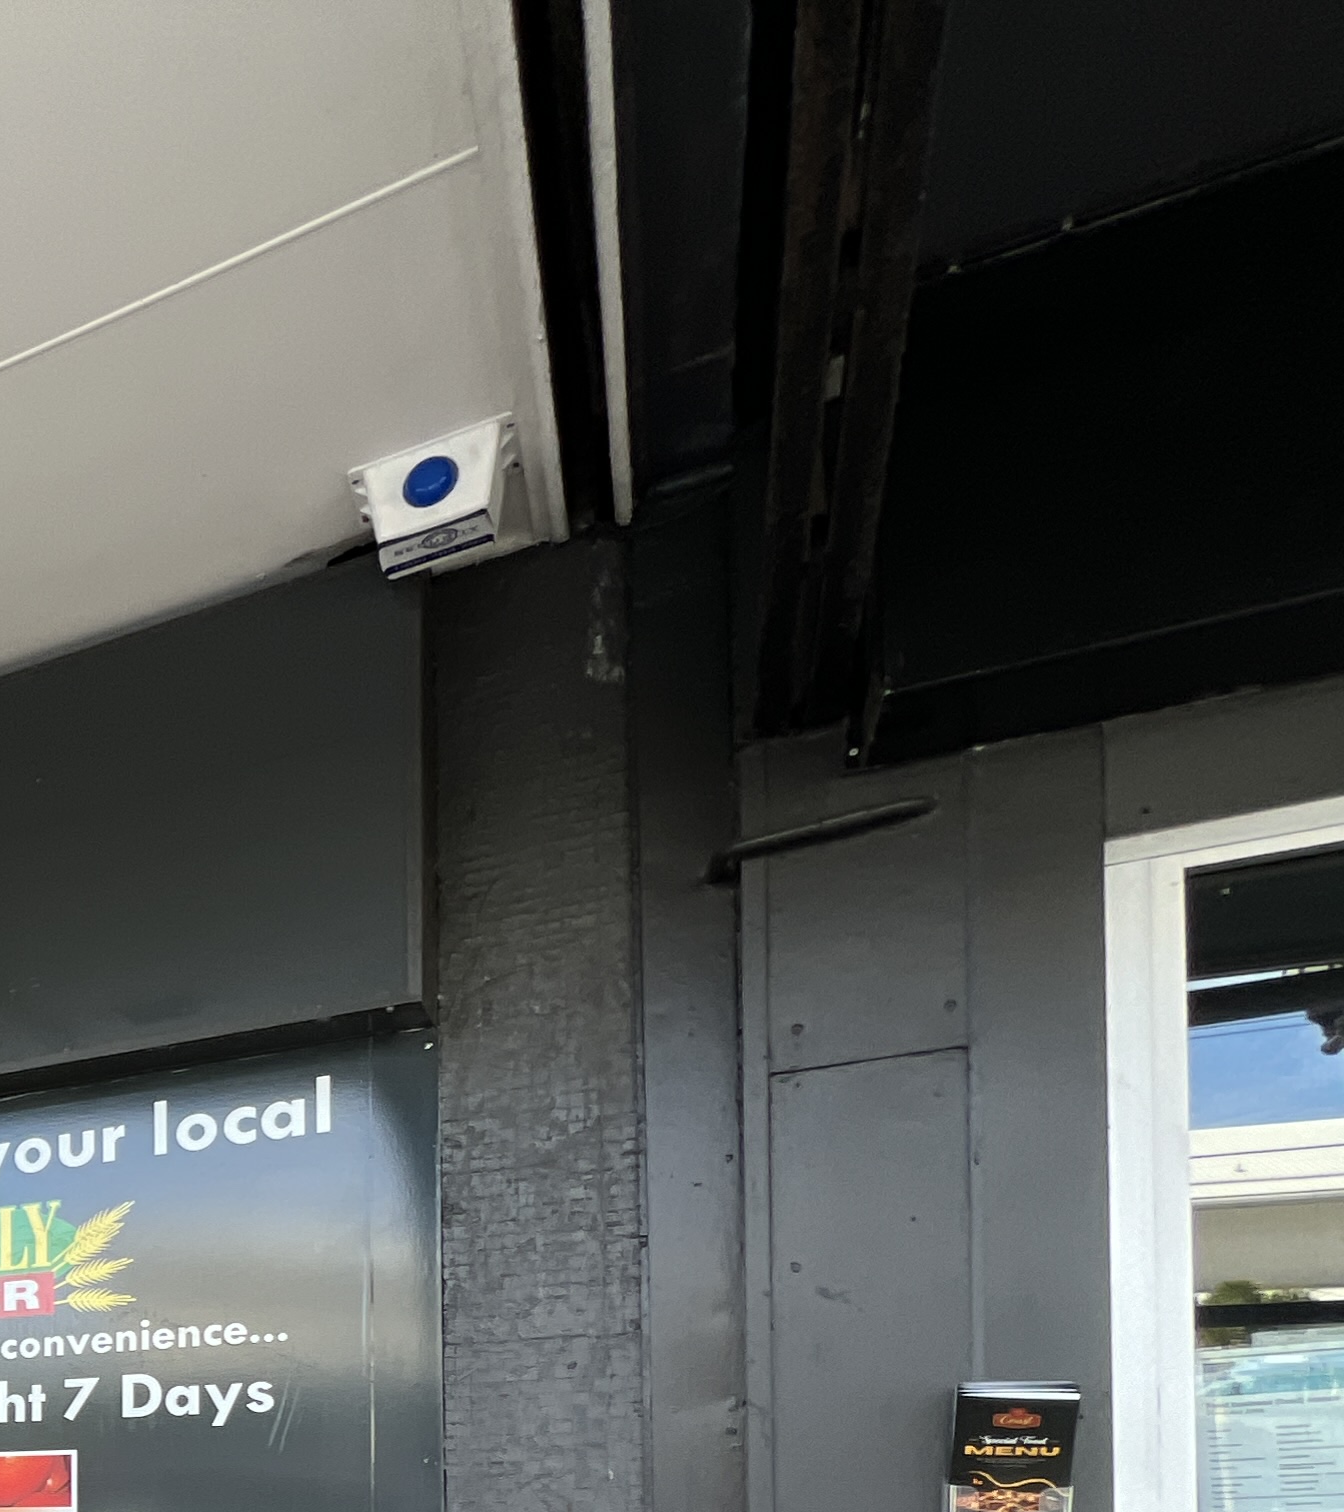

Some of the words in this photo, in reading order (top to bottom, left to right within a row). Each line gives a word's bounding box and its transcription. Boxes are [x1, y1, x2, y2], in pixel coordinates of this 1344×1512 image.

[153, 1076, 333, 1157] local
[1, 1318, 289, 1360] convenience...
[60, 1377, 100, 1423] 7
[120, 1372, 277, 1427] Days
[964, 1445, 1062, 1457] MENU
